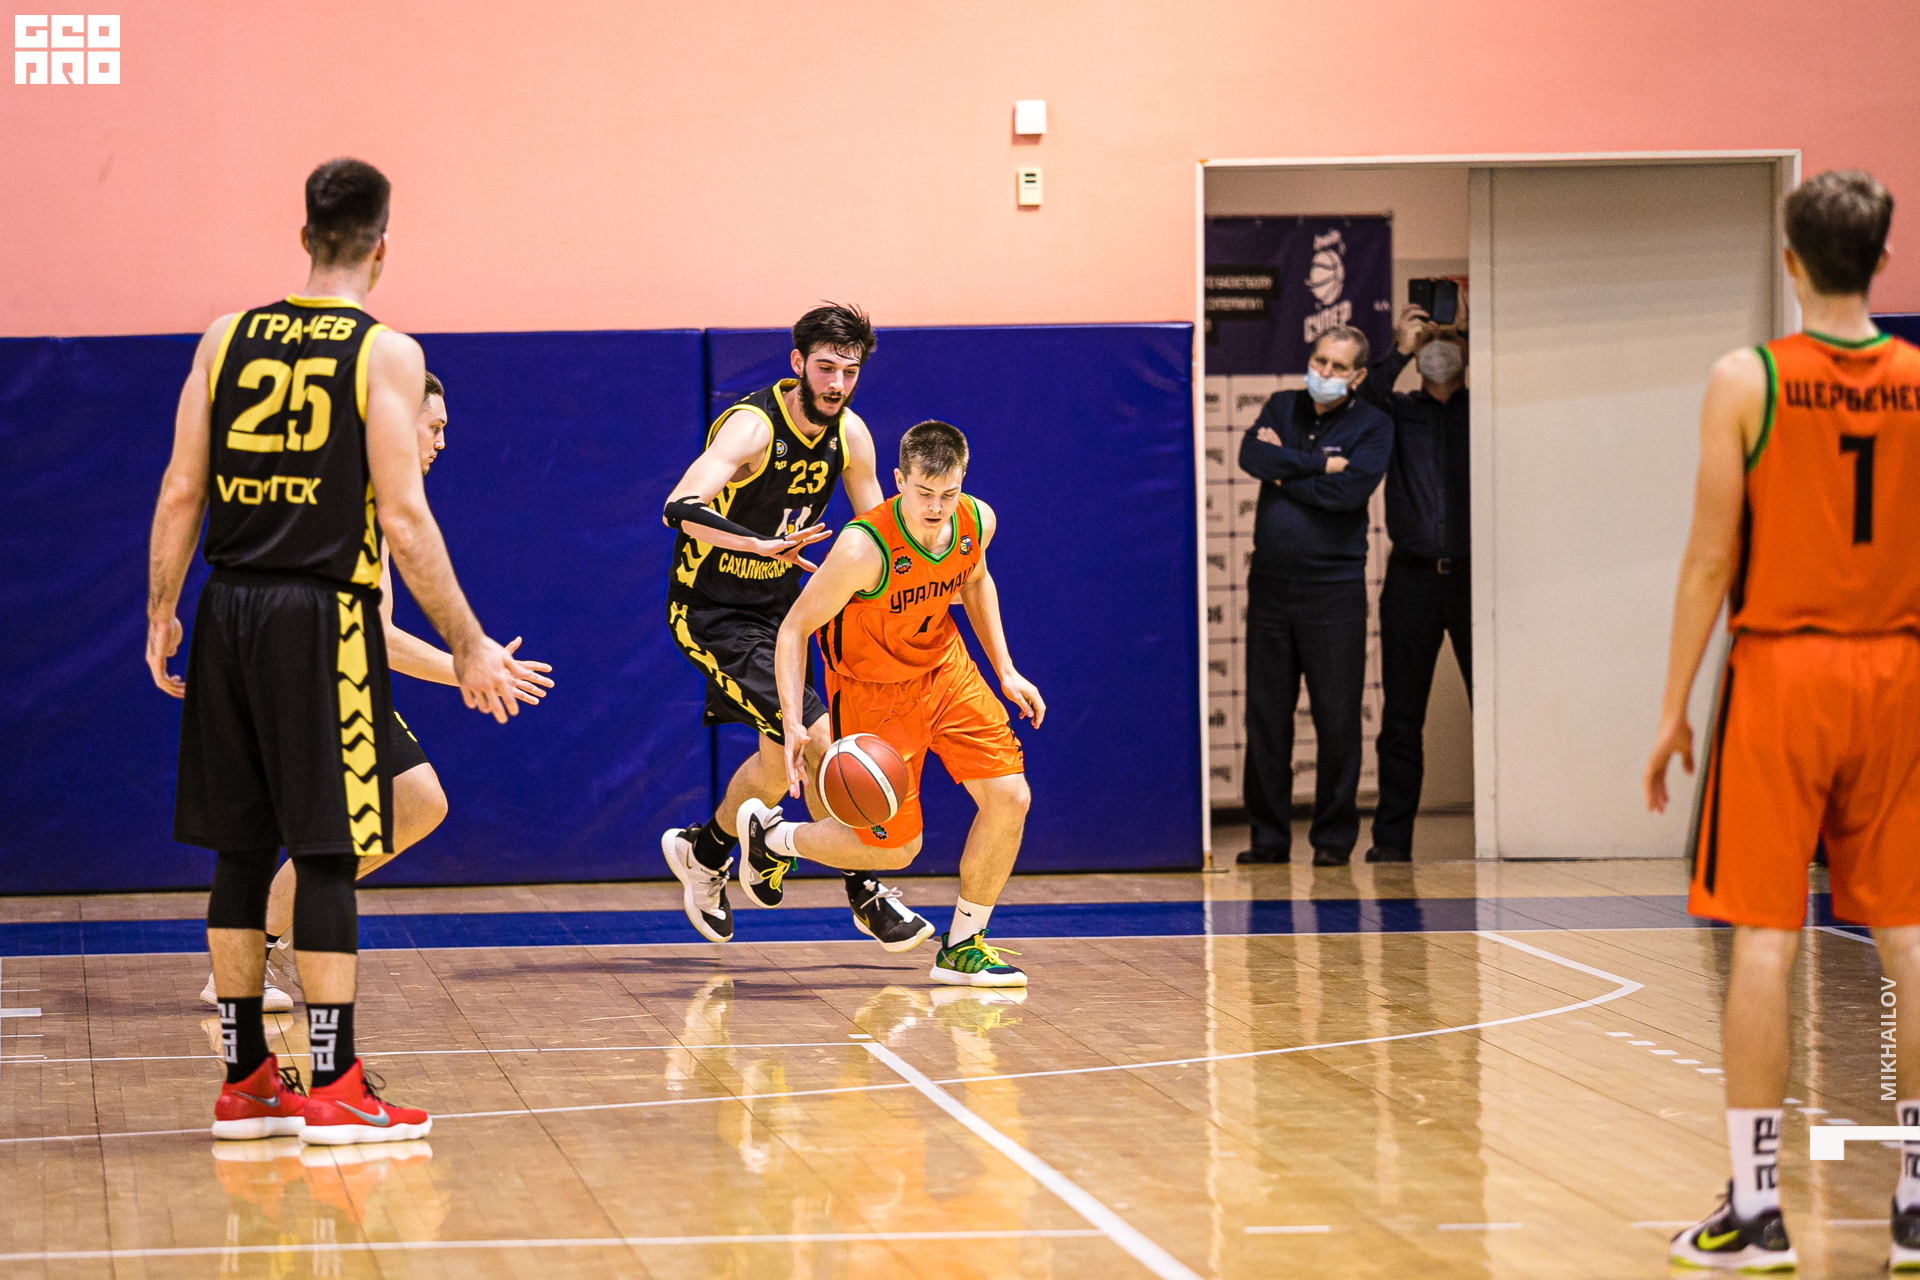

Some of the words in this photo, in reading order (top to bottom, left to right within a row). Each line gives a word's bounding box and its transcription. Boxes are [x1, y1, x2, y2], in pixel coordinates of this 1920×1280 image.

[227, 357, 338, 453] 25
[787, 459, 829, 494] 23
[1839, 434, 1877, 545] 1
